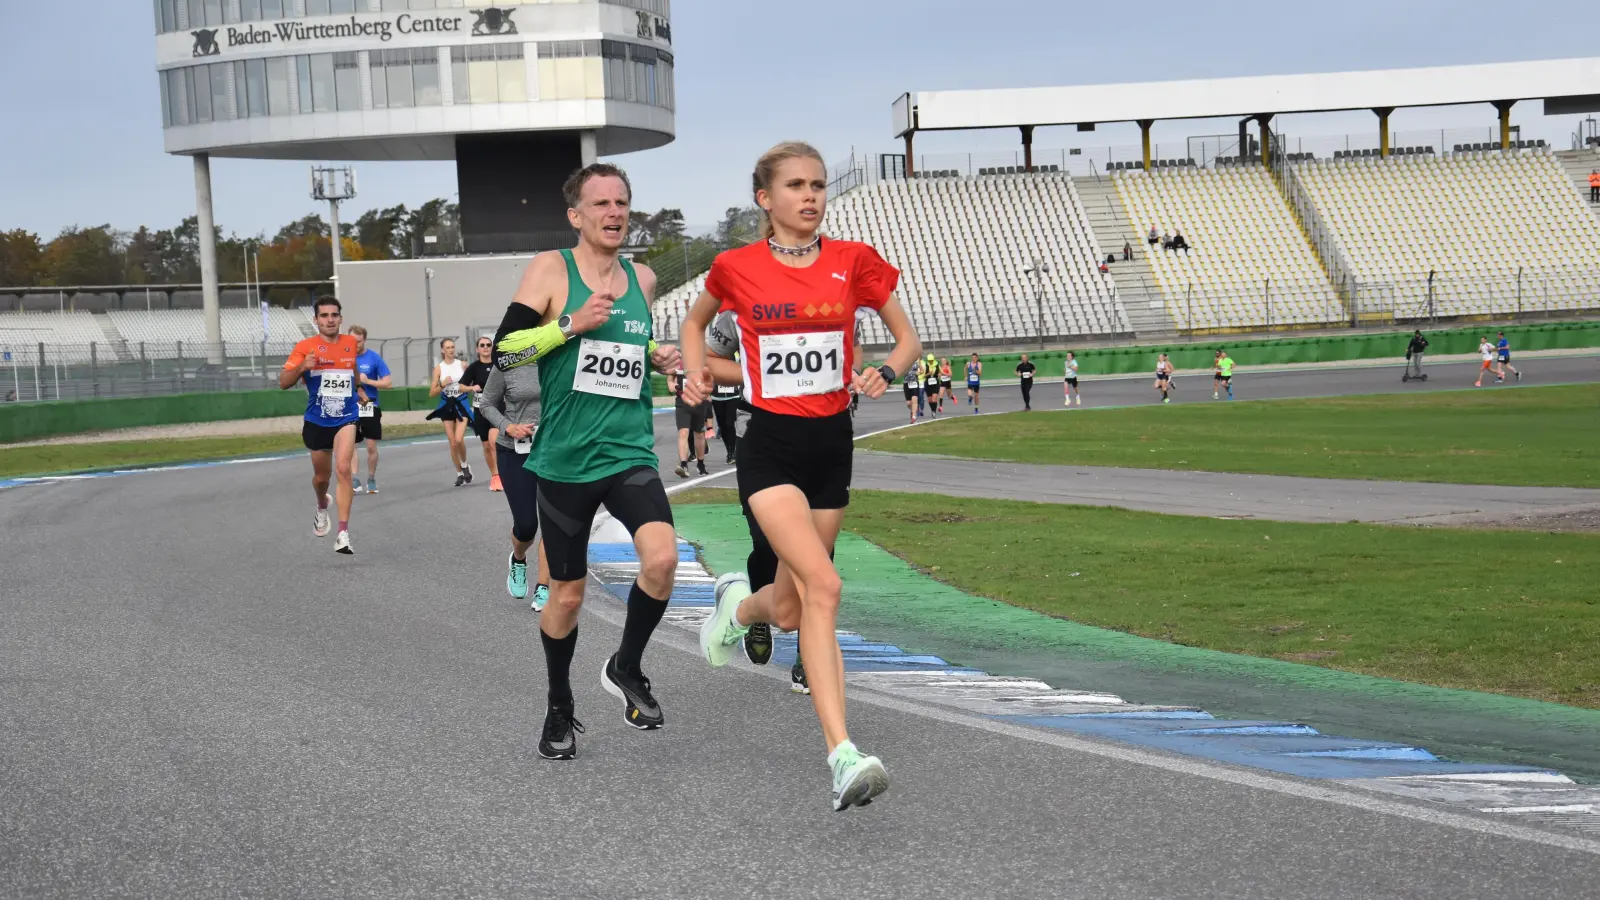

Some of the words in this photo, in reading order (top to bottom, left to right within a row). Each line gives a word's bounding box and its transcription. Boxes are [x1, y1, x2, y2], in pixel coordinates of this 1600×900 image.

[227, 16, 392, 46] Baden-Württemberg
[396, 13, 462, 34] Center
[752, 303, 797, 320] SWE
[624, 320, 646, 335] TSV
[581, 354, 642, 380] 2096
[766, 348, 837, 375] 2001
[323, 379, 351, 389] 2547
[595, 380, 630, 390] Johannes
[797, 379, 814, 387] Lisa
